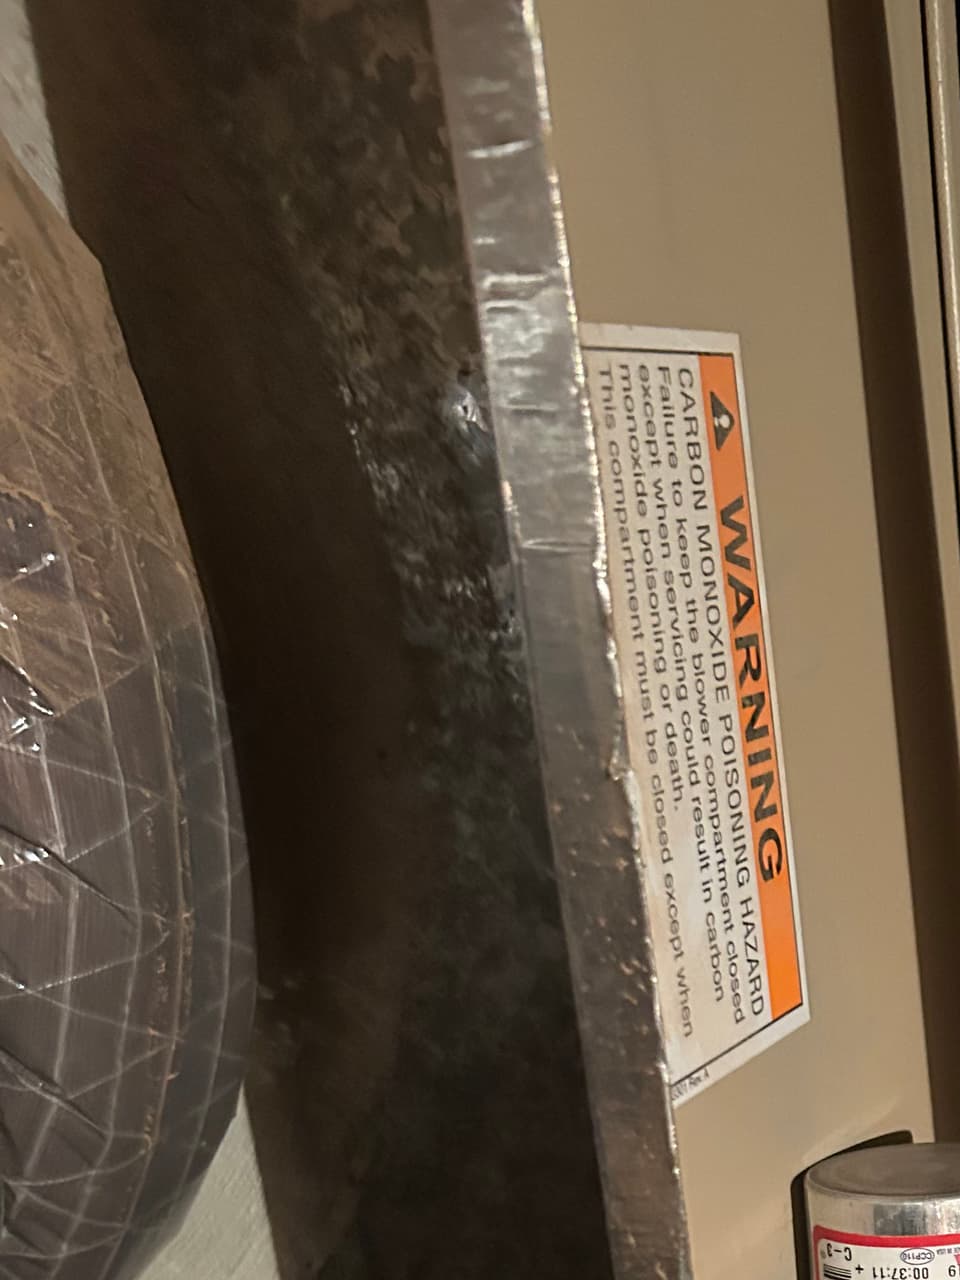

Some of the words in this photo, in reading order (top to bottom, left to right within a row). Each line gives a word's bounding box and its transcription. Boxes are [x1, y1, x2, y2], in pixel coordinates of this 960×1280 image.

[599, 364, 617, 430] This
[638, 365, 662, 468] except
[658, 367, 679, 469] Failure
[619, 365, 648, 516] monoxide
[653, 478, 670, 559] when
[670, 481, 686, 506] to
[608, 441, 644, 639] compartment
[675, 519, 697, 588] keep
[638, 529, 668, 673] poisoning
[664, 570, 692, 701] servicing
[685, 599, 702, 643] the
[634, 650, 655, 720] must
[660, 684, 672, 709] or
[678, 368, 708, 510] CARBON
[696, 525, 730, 703] MONOXIDE
[719, 714, 750, 887] POISONING
[740, 897, 764, 1016] HAZARD
[691, 654, 712, 745] blower
[720, 496, 783, 882] WARNING
[646, 730, 659, 764] be
[665, 722, 684, 812] death.
[681, 711, 700, 786] could
[651, 775, 673, 864] closed
[692, 797, 711, 870] result
[704, 755, 734, 934] compartment
[664, 873, 684, 960] except
[702, 879, 713, 902] in
[706, 912, 725, 1002] carbon
[726, 941, 745, 1024] closed
[676, 968, 694, 1038] when
[873, 1267, 928, 1279] 00:37:11
